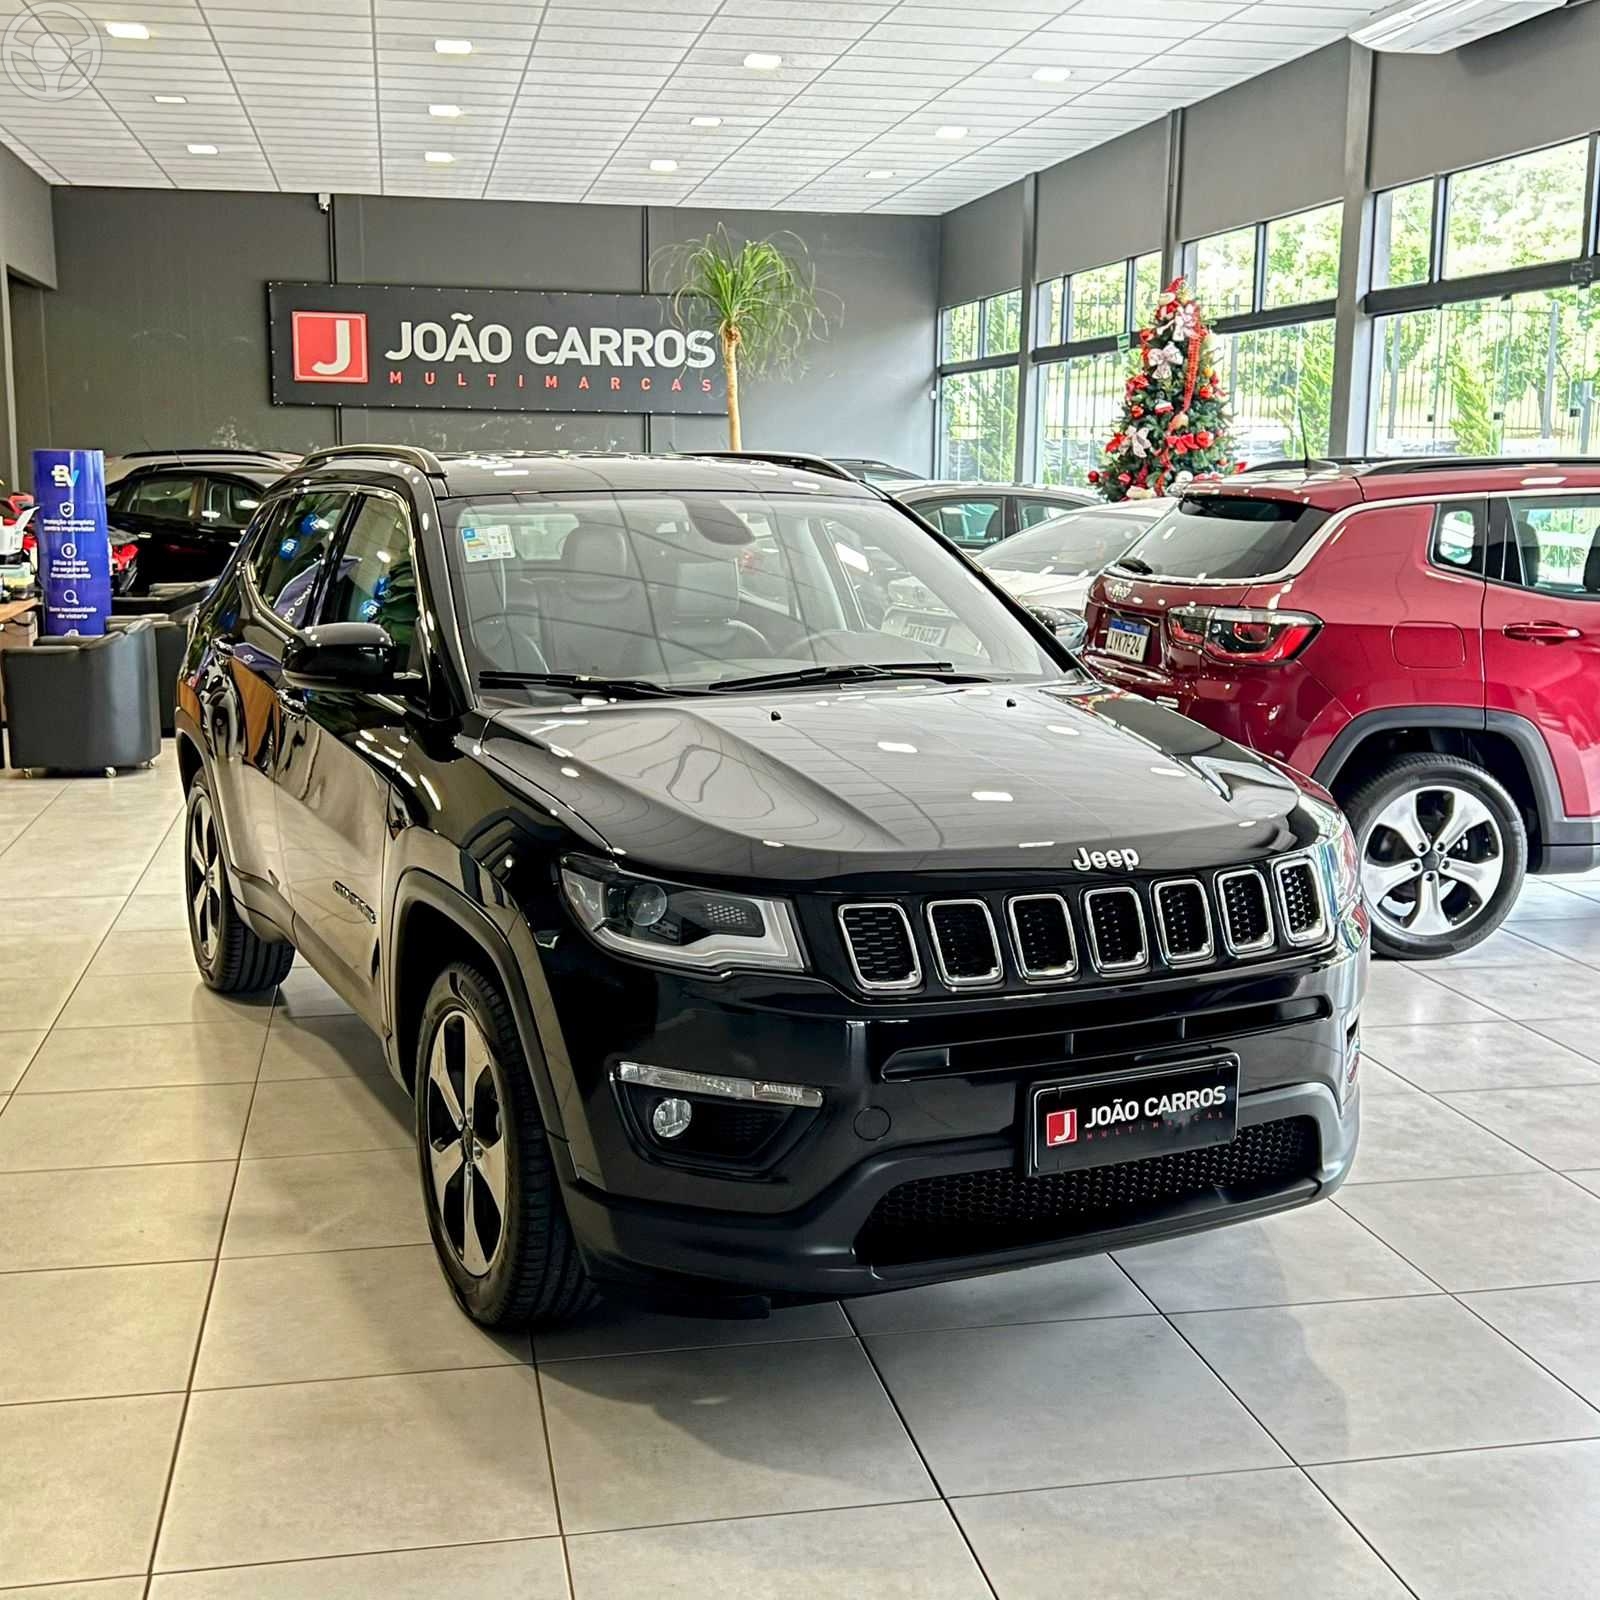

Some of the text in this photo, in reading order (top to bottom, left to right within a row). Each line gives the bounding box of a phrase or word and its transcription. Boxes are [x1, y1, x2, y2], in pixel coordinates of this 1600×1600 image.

[384, 312, 716, 368] JOÃO CARROS
[389, 370, 713, 392] MULTIMARCAS
[1073, 847, 1140, 871] Jeep
[1084, 1085, 1227, 1129] JOÃO CARROS
